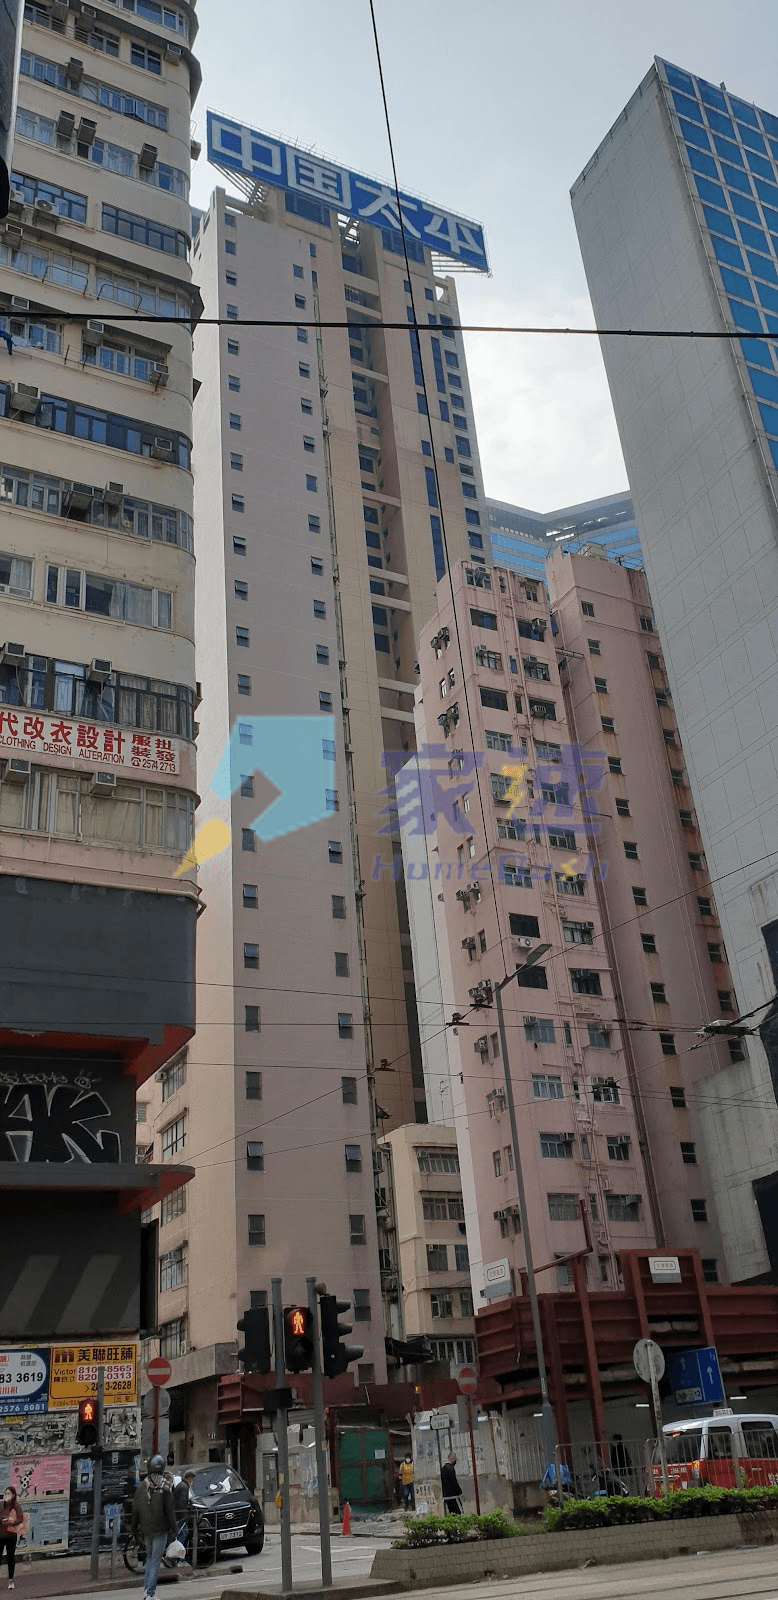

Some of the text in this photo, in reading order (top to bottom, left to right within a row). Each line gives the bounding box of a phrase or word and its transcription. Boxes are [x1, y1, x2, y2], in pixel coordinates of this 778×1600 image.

[211, 118, 483, 256] 中国太平
[0, 711, 126, 754] 代改衣設計
[0, 736, 125, 764] CLOTHING DESIGN ALTERATION
[142, 758, 176, 773] 2574 2713
[78, 1364, 132, 1374] 810-8565
[16, 1371, 44, 1383] 3619
[77, 1372, 132, 1382] 820-0313
